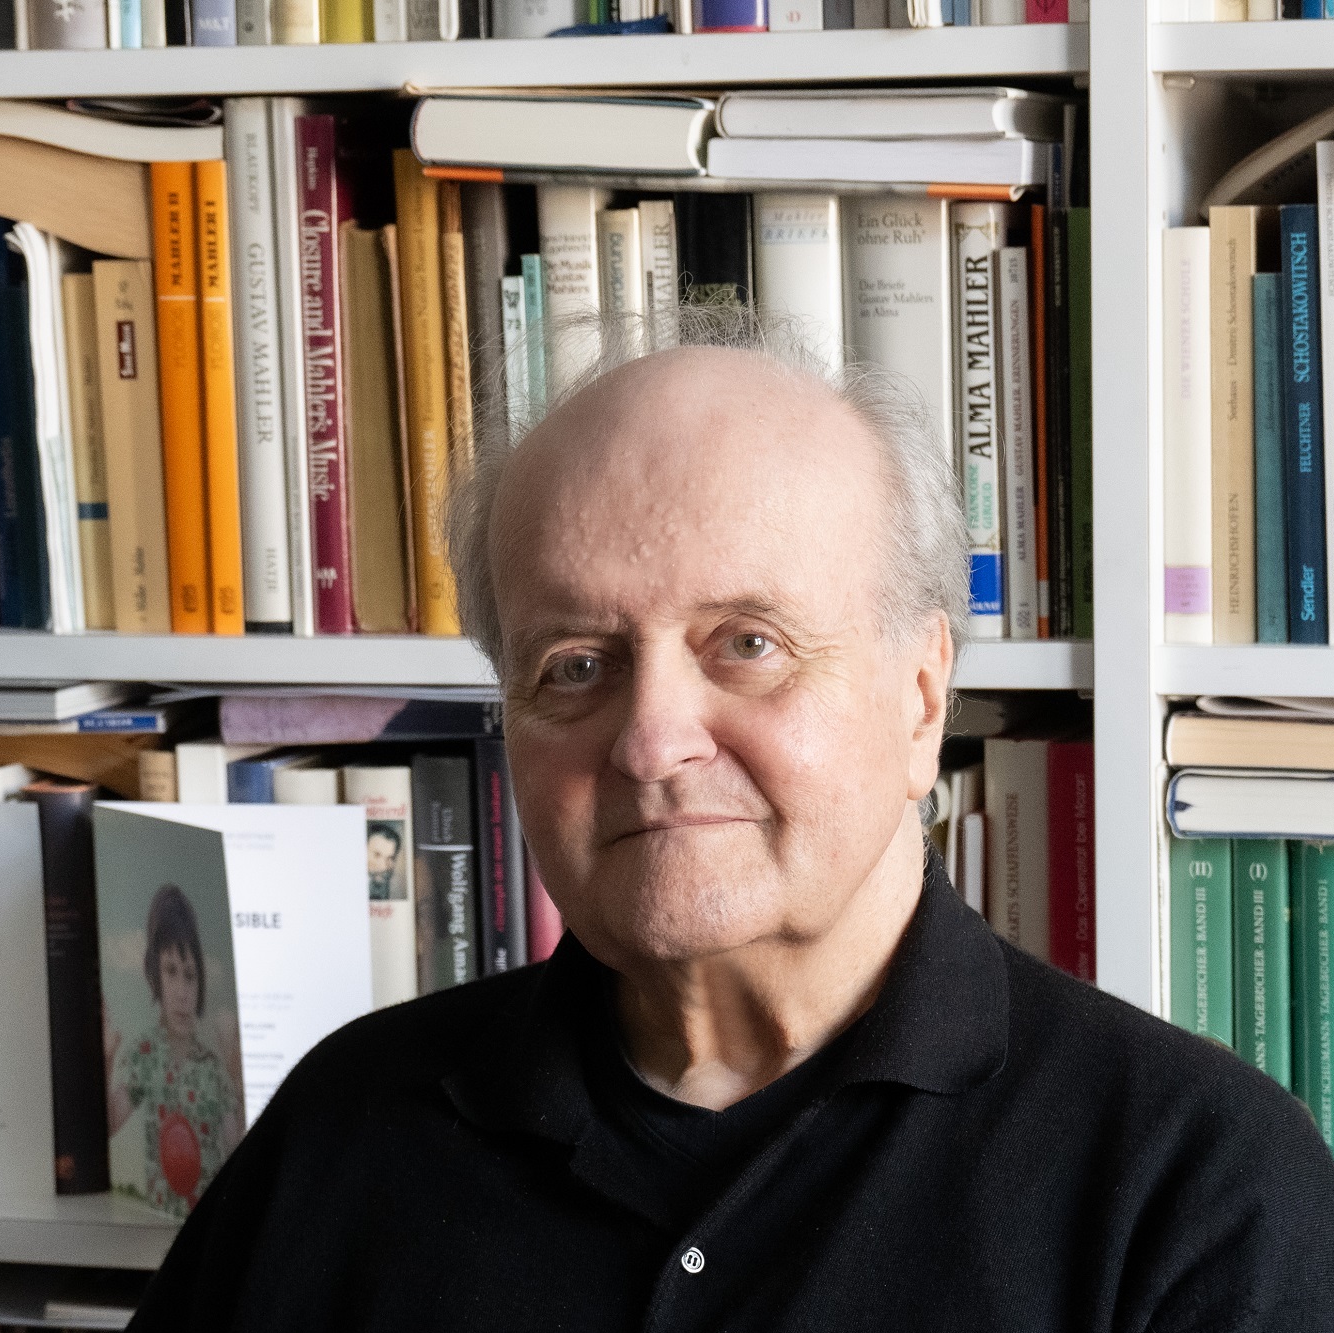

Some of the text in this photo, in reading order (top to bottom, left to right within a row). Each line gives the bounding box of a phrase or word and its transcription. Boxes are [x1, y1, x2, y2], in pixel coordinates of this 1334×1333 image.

[301, 209, 330, 277] Closure
[857, 212, 923, 229] Ein Glück
[857, 231, 889, 245] ohne
[167, 211, 182, 286] MAHLER
[205, 217, 220, 288] MAHLER
[305, 283, 333, 337] and
[859, 279, 906, 292] Die Briefe
[859, 291, 934, 305] Gustav Mahlers
[875, 304, 900, 317] Alma
[1226, 237, 1239, 366] Dmitrij Schostakowitsch
[249, 243, 273, 444] GUSTAV MAHLER
[1009, 300, 1022, 384] ERINNERUNGEN
[1179, 258, 1192, 399] DIE WIENER SCHULE
[1291, 232, 1312, 472] FEUCHTNER SCHOSTAKOWITSCH
[965, 255, 992, 460] ALMA MAHLER
[1227, 380, 1238, 421] Seehaus
[310, 439, 337, 500] Music
[1013, 434, 1025, 476] GUSTAV
[981, 483, 992, 529] GIROUD
[1014, 486, 1026, 529] MAHLER
[1227, 493, 1240, 615] HEINRICHSHOFEN
[1300, 565, 1315, 621] Sendler
[235, 912, 281, 930] SIBLE
[1195, 887, 1207, 941] BAND III
[1253, 890, 1265, 943] BAND III
[1318, 887, 1331, 1094] SCHUMANN BAND
